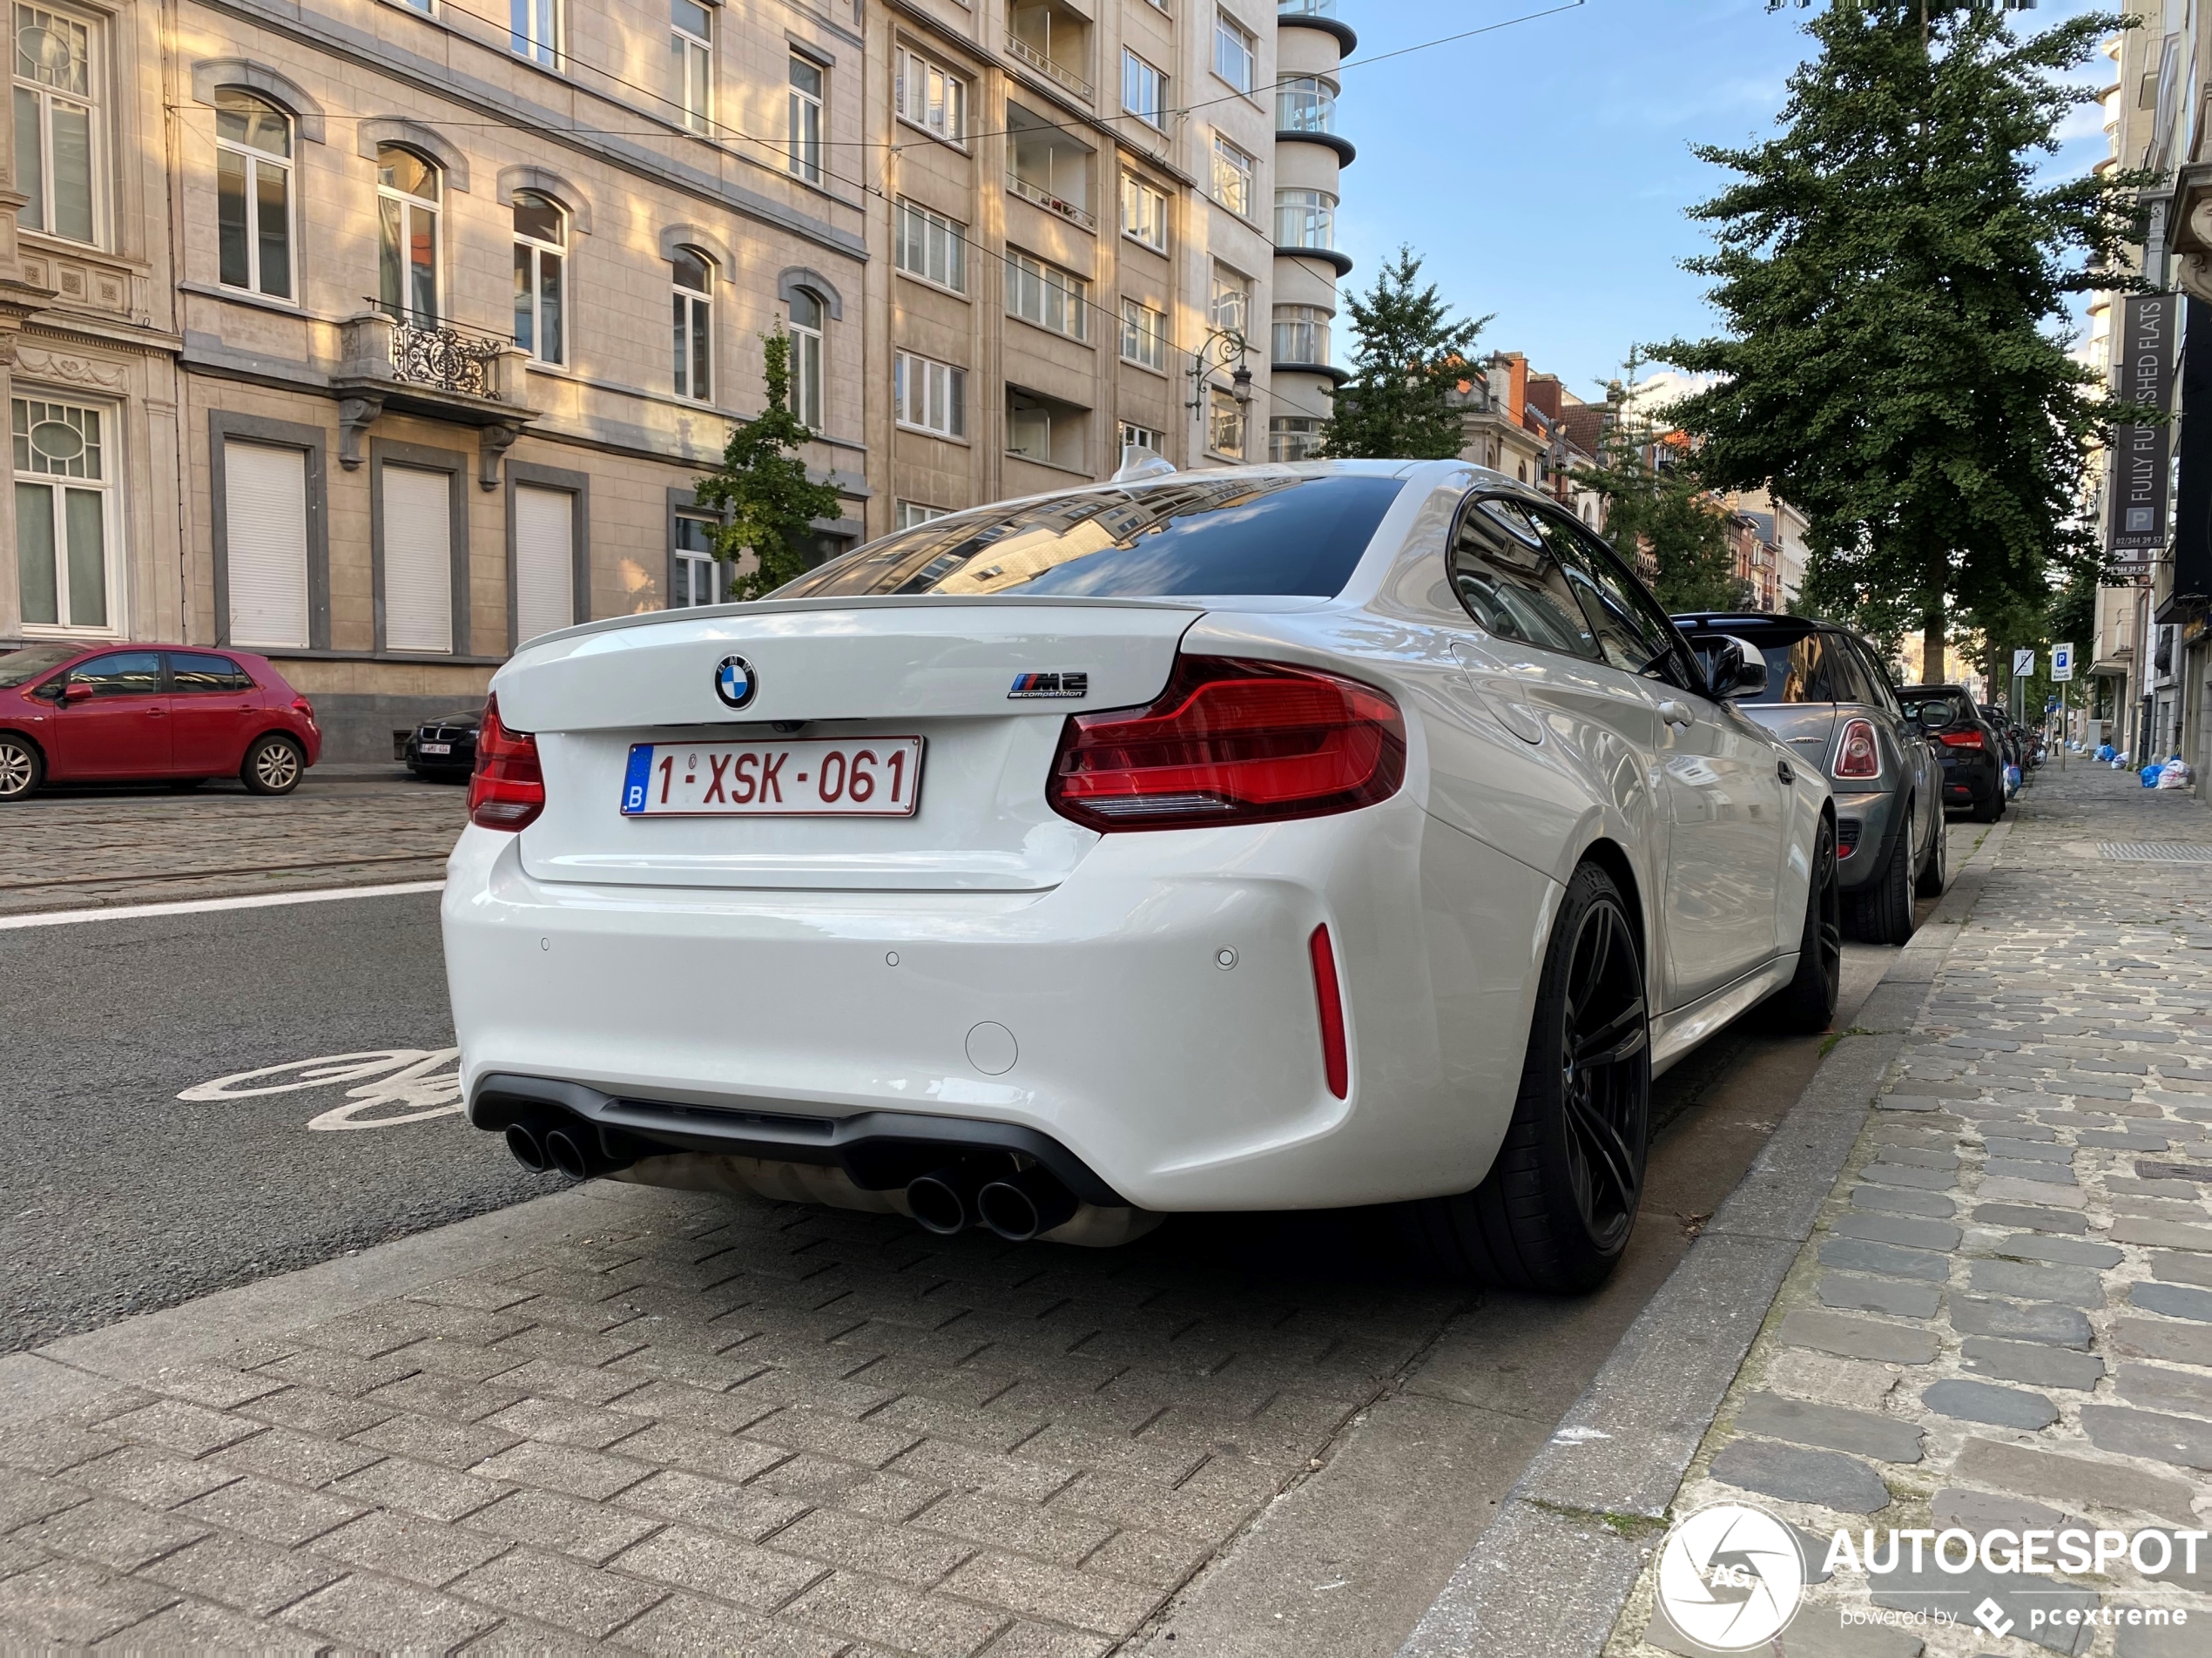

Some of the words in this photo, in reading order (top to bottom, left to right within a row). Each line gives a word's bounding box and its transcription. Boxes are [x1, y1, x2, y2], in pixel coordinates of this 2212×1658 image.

[2138, 301, 2161, 349] FLATS
[2133, 354, 2159, 451] FURISHED
[2131, 456, 2154, 502] FULLY
[2133, 511, 2148, 527] P
[718, 656, 752, 675] BMW
[1022, 690, 1082, 698] competition
[658, 749, 907, 804] 1-XSK-061
[628, 785, 643, 808] B
